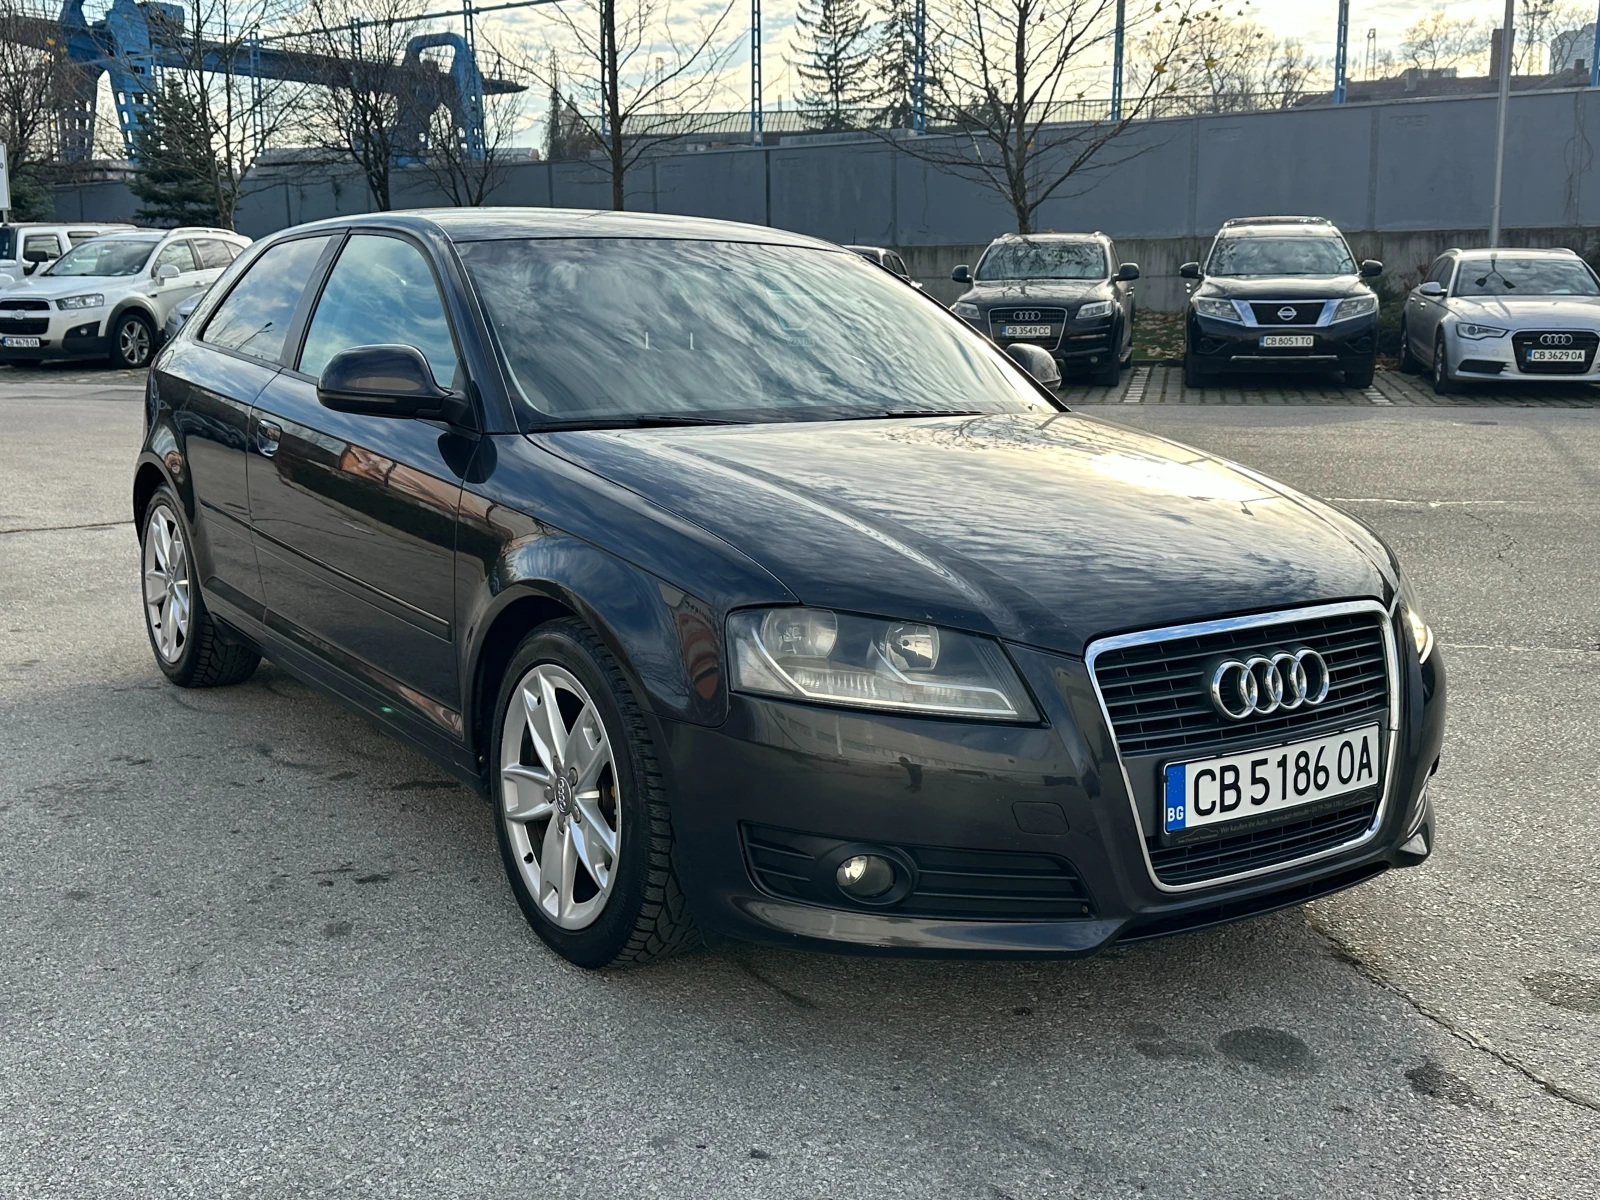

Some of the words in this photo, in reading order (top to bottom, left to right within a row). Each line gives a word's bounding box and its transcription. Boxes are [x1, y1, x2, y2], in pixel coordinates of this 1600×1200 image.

[1007, 327, 1017, 335] CB
[1018, 327, 1038, 335] 3549
[1038, 327, 1049, 335] CC
[1265, 337, 1277, 346] CB
[1278, 337, 1299, 346] 8051
[1300, 337, 1312, 346] TO
[1533, 351, 1546, 360] CB
[1546, 351, 1570, 360] 3629
[1570, 351, 1583, 360] OA
[1193, 764, 1242, 817] CB
[1250, 745, 1330, 806] 5186
[1337, 735, 1373, 785] OA
[1167, 805, 1185, 823] BG
